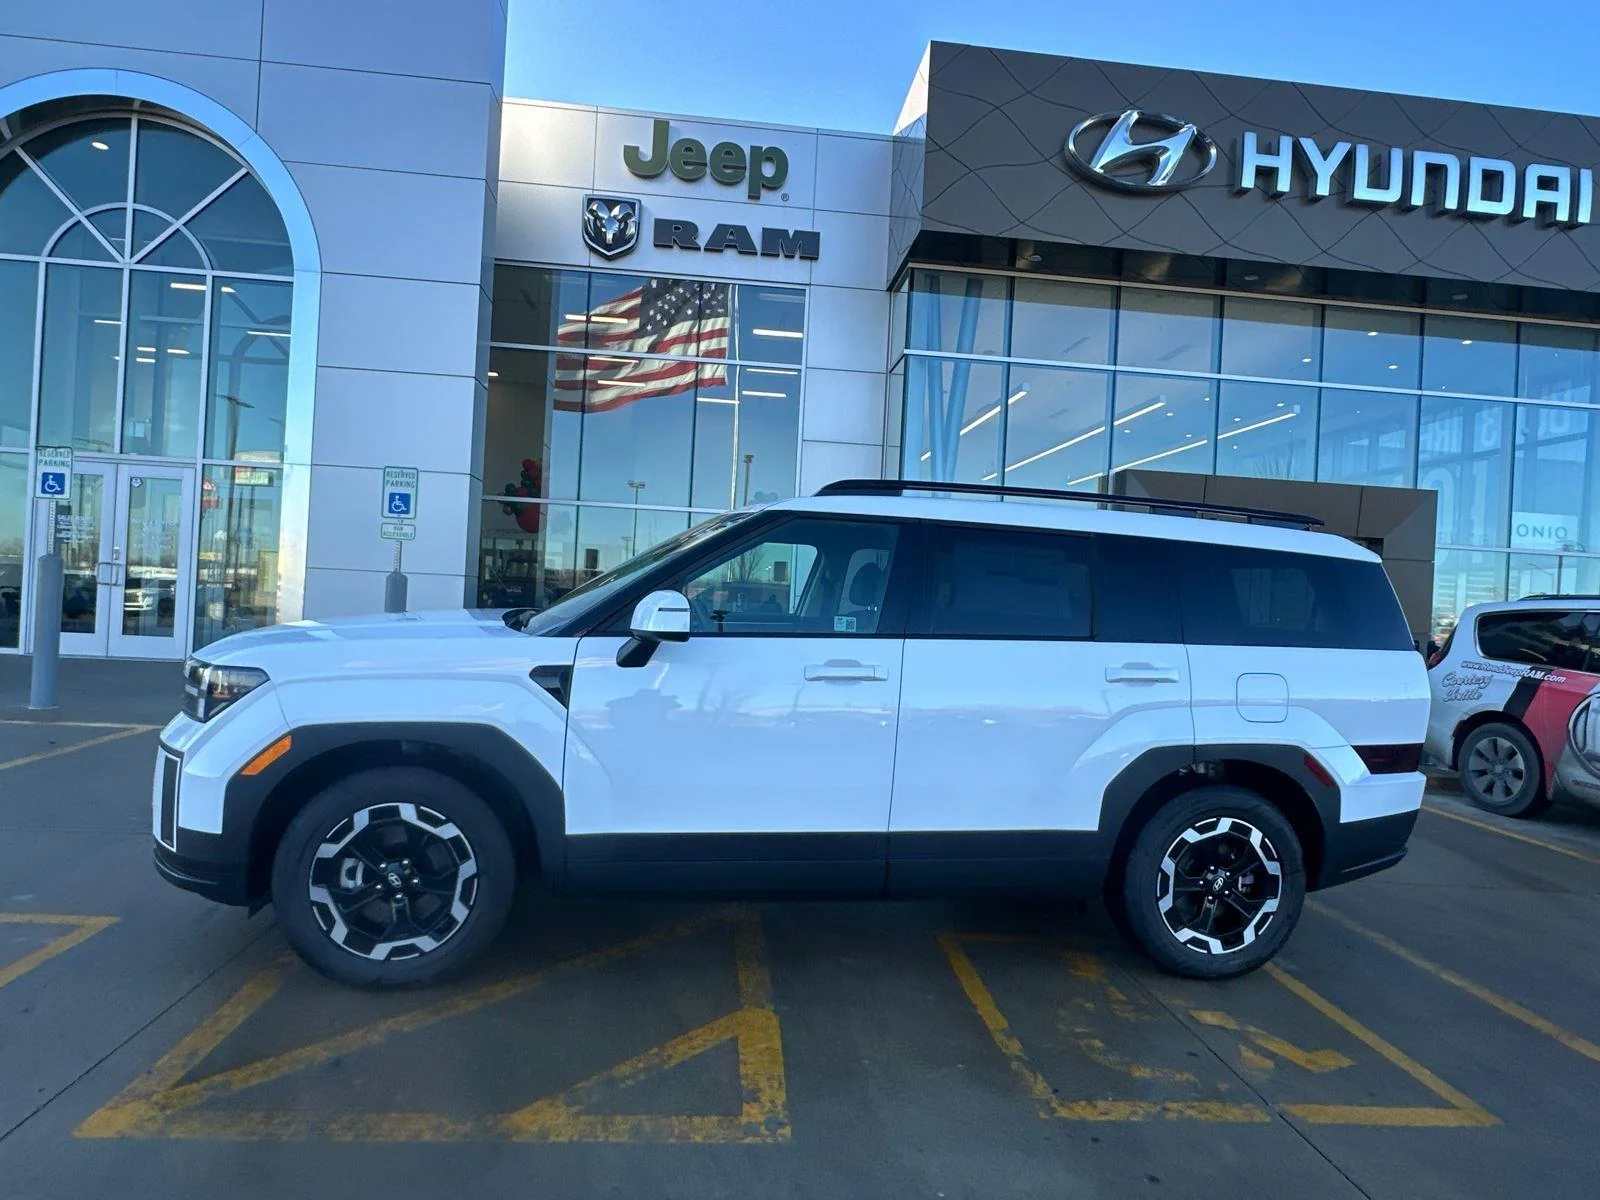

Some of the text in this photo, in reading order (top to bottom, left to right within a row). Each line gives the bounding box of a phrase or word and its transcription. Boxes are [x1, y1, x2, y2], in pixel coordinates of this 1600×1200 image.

[623, 119, 789, 200] Jeep
[1239, 131, 1593, 225] HYUNDAI
[653, 217, 821, 260] RAM
[38, 449, 70, 458] RESERVED
[38, 459, 70, 468] PARKING
[386, 470, 416, 479] RESERVED
[385, 480, 416, 489] PARKING
